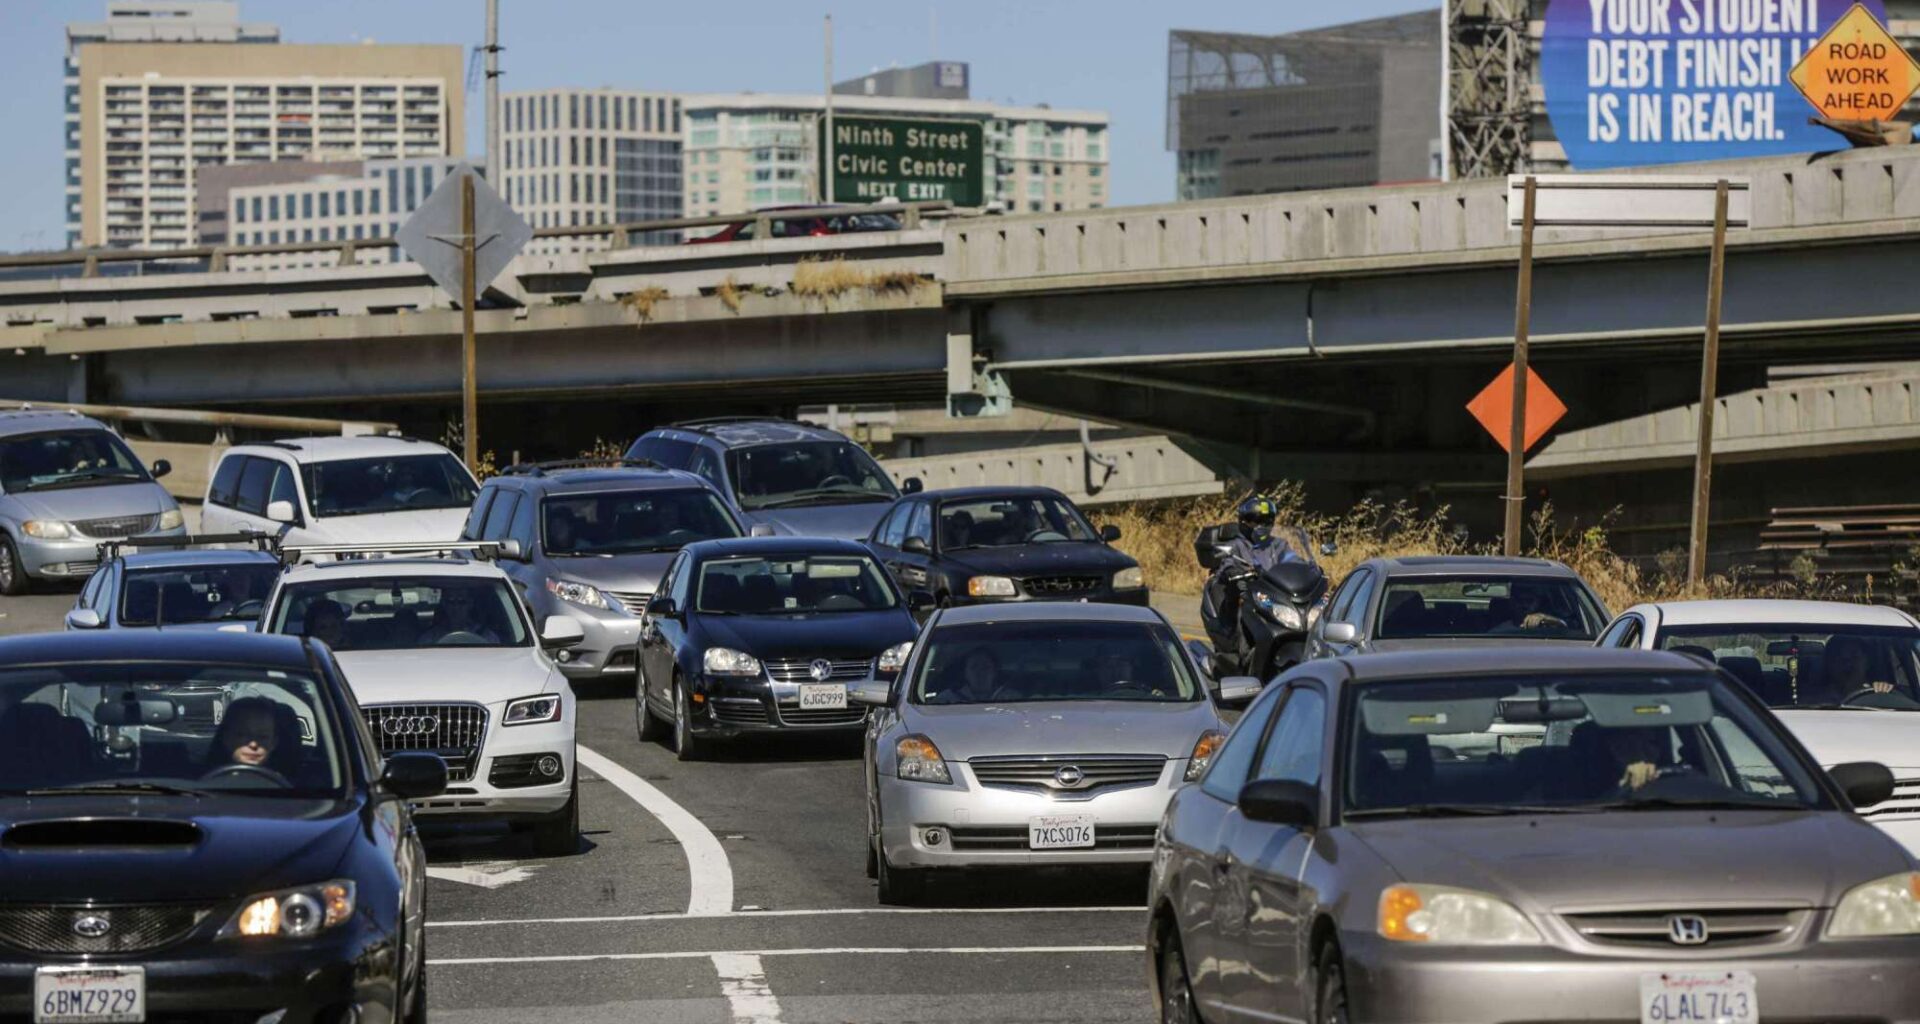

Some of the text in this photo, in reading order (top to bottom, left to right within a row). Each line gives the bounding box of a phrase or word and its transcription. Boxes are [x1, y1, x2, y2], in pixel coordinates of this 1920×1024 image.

[1589, 0, 1671, 35] YOUR
[1588, 39, 1669, 88] DEBT
[1676, 38, 1782, 88] FINISH
[1829, 43, 1886, 60] ROAD
[1826, 67, 1889, 84] WORK
[1823, 92, 1894, 109] AHEAD
[1588, 91, 1785, 143] IS IN REACH.
[837, 125, 968, 149] Ninth Street
[837, 154, 967, 177] Civic Center
[857, 182, 945, 200] NEXT EXIT
[803, 693, 843, 704] 6JGC999
[1034, 827, 1089, 843] 7XCS076
[44, 989, 136, 1015] 6BMZ929
[1650, 992, 1749, 1020] 6LAL743
